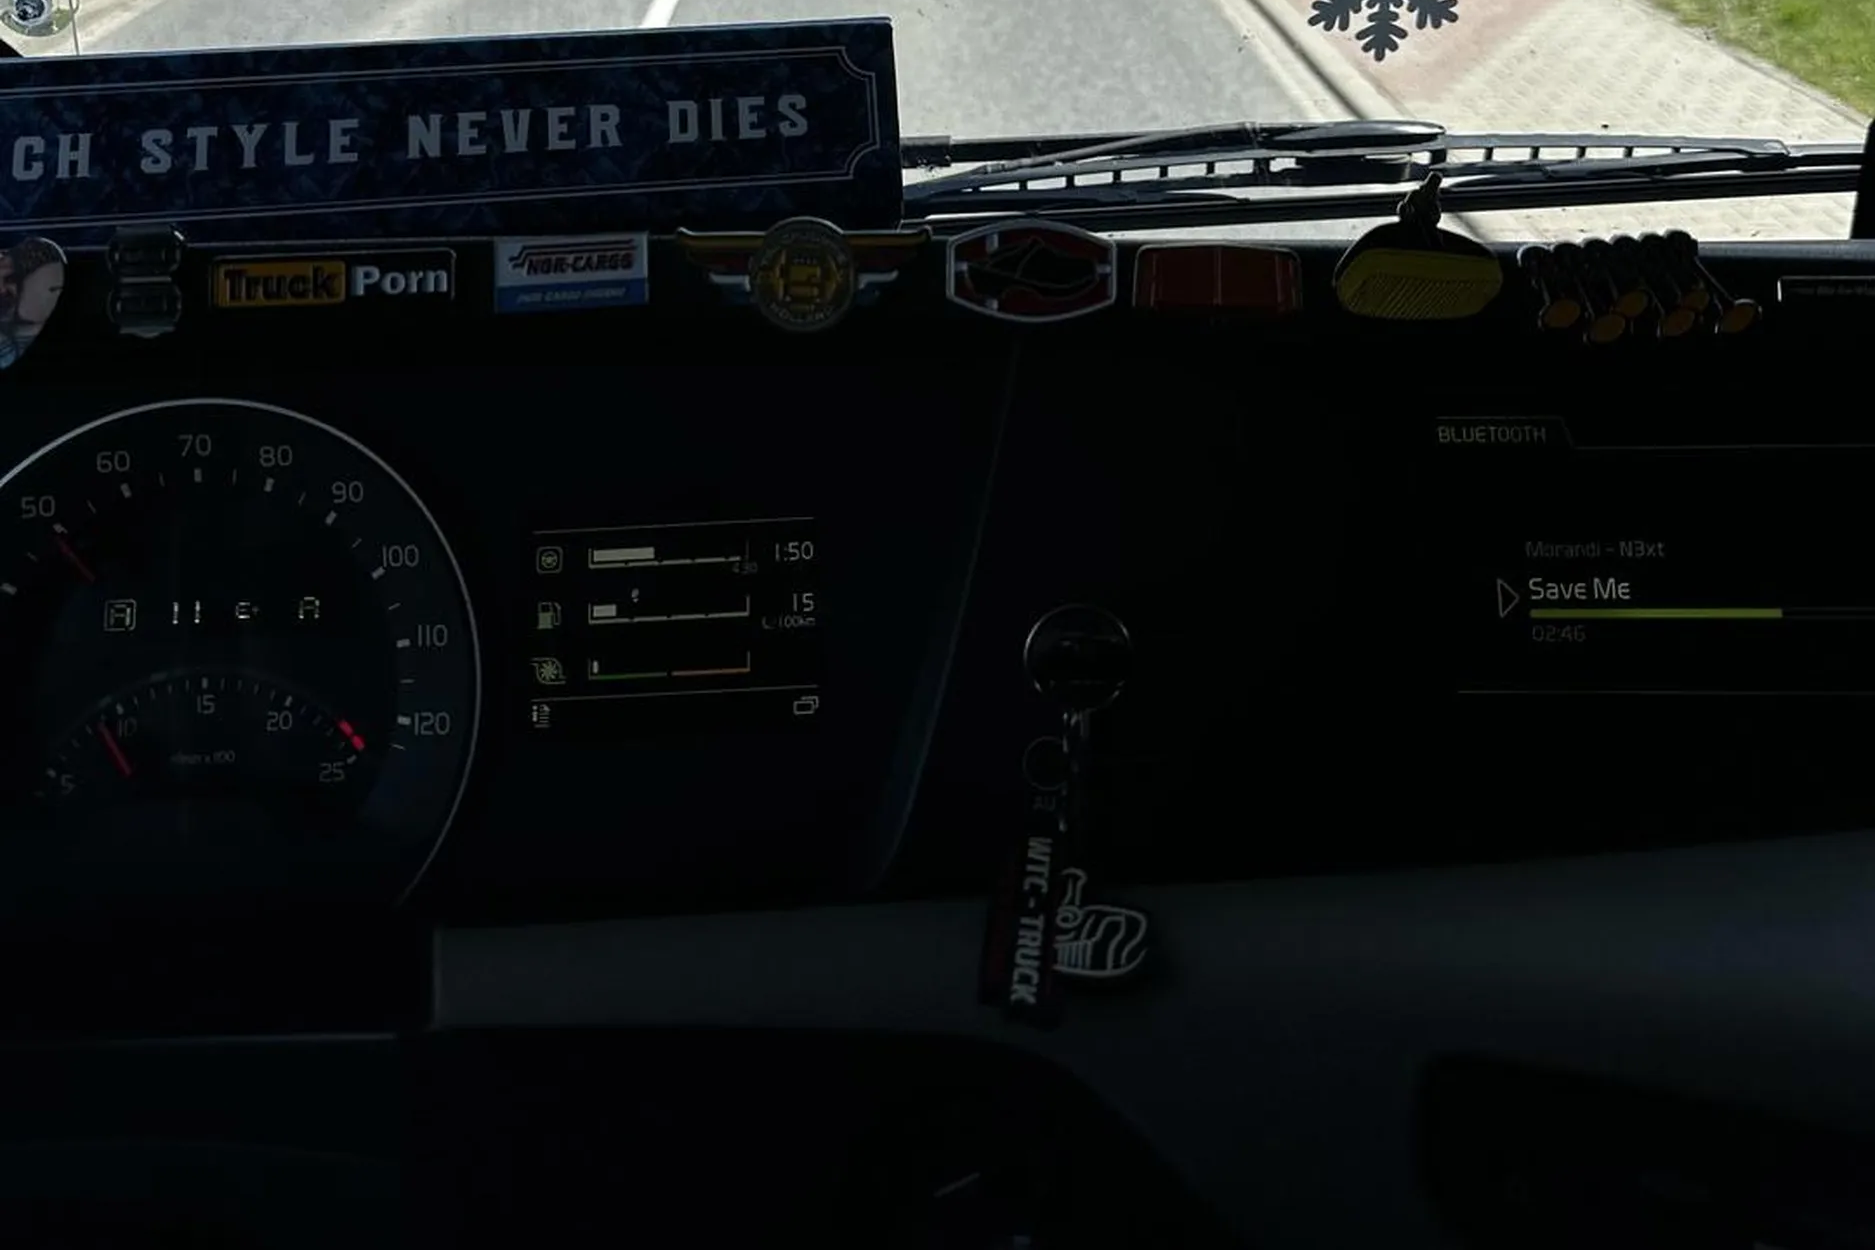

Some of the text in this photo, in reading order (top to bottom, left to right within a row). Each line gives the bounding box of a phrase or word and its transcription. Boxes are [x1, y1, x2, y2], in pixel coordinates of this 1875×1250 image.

[12, 93, 809, 181] CH STYLE NEVER DIES
[223, 263, 449, 303] Truck Porn
[178, 433, 212, 459] 70
[1436, 424, 1547, 445] BLUETOOTH
[96, 450, 131, 473] 60
[259, 444, 293, 468] 80
[331, 481, 364, 505] 90
[20, 495, 57, 520] 50
[381, 545, 420, 569] 100
[1524, 540, 1601, 558] Morandi
[1528, 577, 1632, 601] Save Me
[792, 592, 815, 613] 15
[416, 624, 449, 648] 110
[1532, 625, 1587, 643] 02:46
[266, 711, 293, 731] 20
[413, 710, 451, 736] 120
[319, 762, 346, 783] 25
[1022, 835, 1053, 895] WTC
[1009, 913, 1046, 1006] TRUCK
